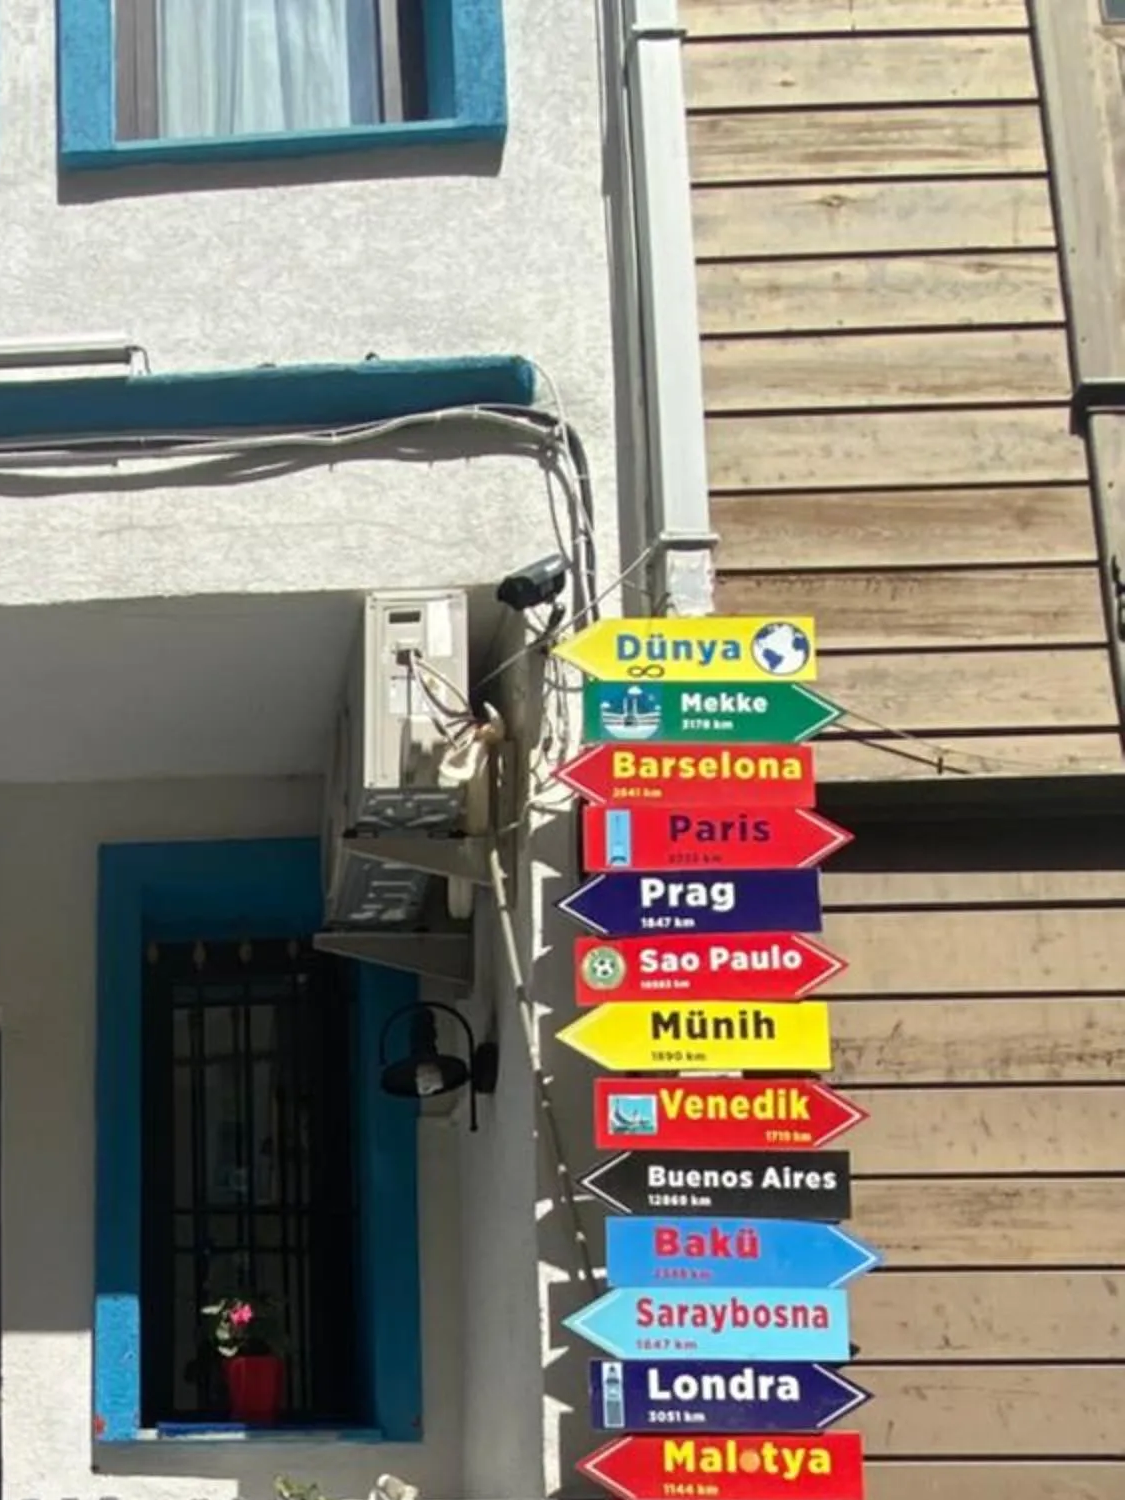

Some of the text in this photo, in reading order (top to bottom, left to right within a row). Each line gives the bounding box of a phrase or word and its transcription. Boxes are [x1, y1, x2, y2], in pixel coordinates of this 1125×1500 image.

[616, 634, 741, 666] Dünya
[681, 692, 768, 714] Mekke
[612, 752, 803, 780] Barselona
[669, 814, 770, 842] Paris
[640, 878, 734, 911] Prag
[639, 944, 802, 973] Sao Paulo
[651, 1010, 775, 1040] Münih
[659, 1088, 811, 1121] Venedik
[647, 1166, 837, 1190] Buenos Aires
[654, 1227, 759, 1259] Bakü
[636, 1297, 829, 1333] Saraybosna
[648, 1368, 800, 1402] Londra
